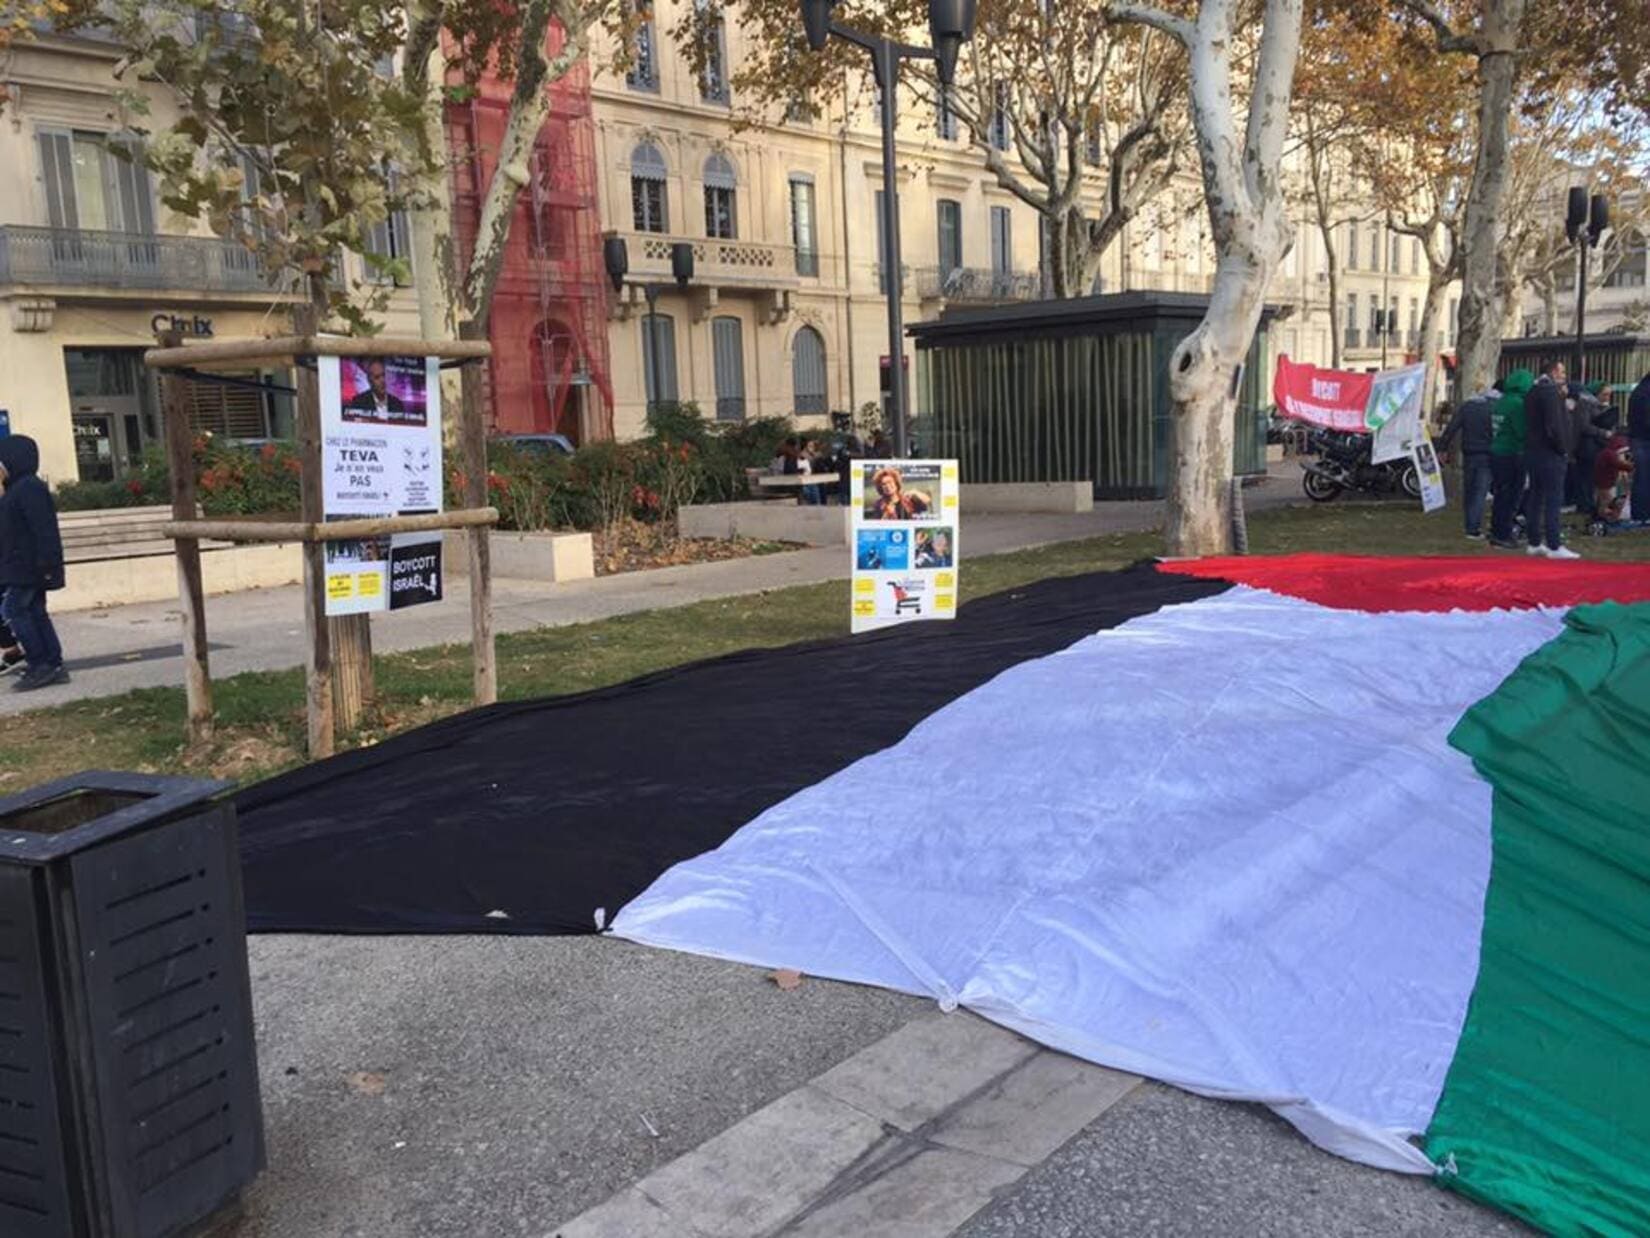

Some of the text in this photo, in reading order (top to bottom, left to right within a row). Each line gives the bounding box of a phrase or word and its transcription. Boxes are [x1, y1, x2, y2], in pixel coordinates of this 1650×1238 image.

[339, 449, 379, 462] TEVA
[350, 474, 372, 487] PAS
[393, 555, 436, 573] BOYCOTT
